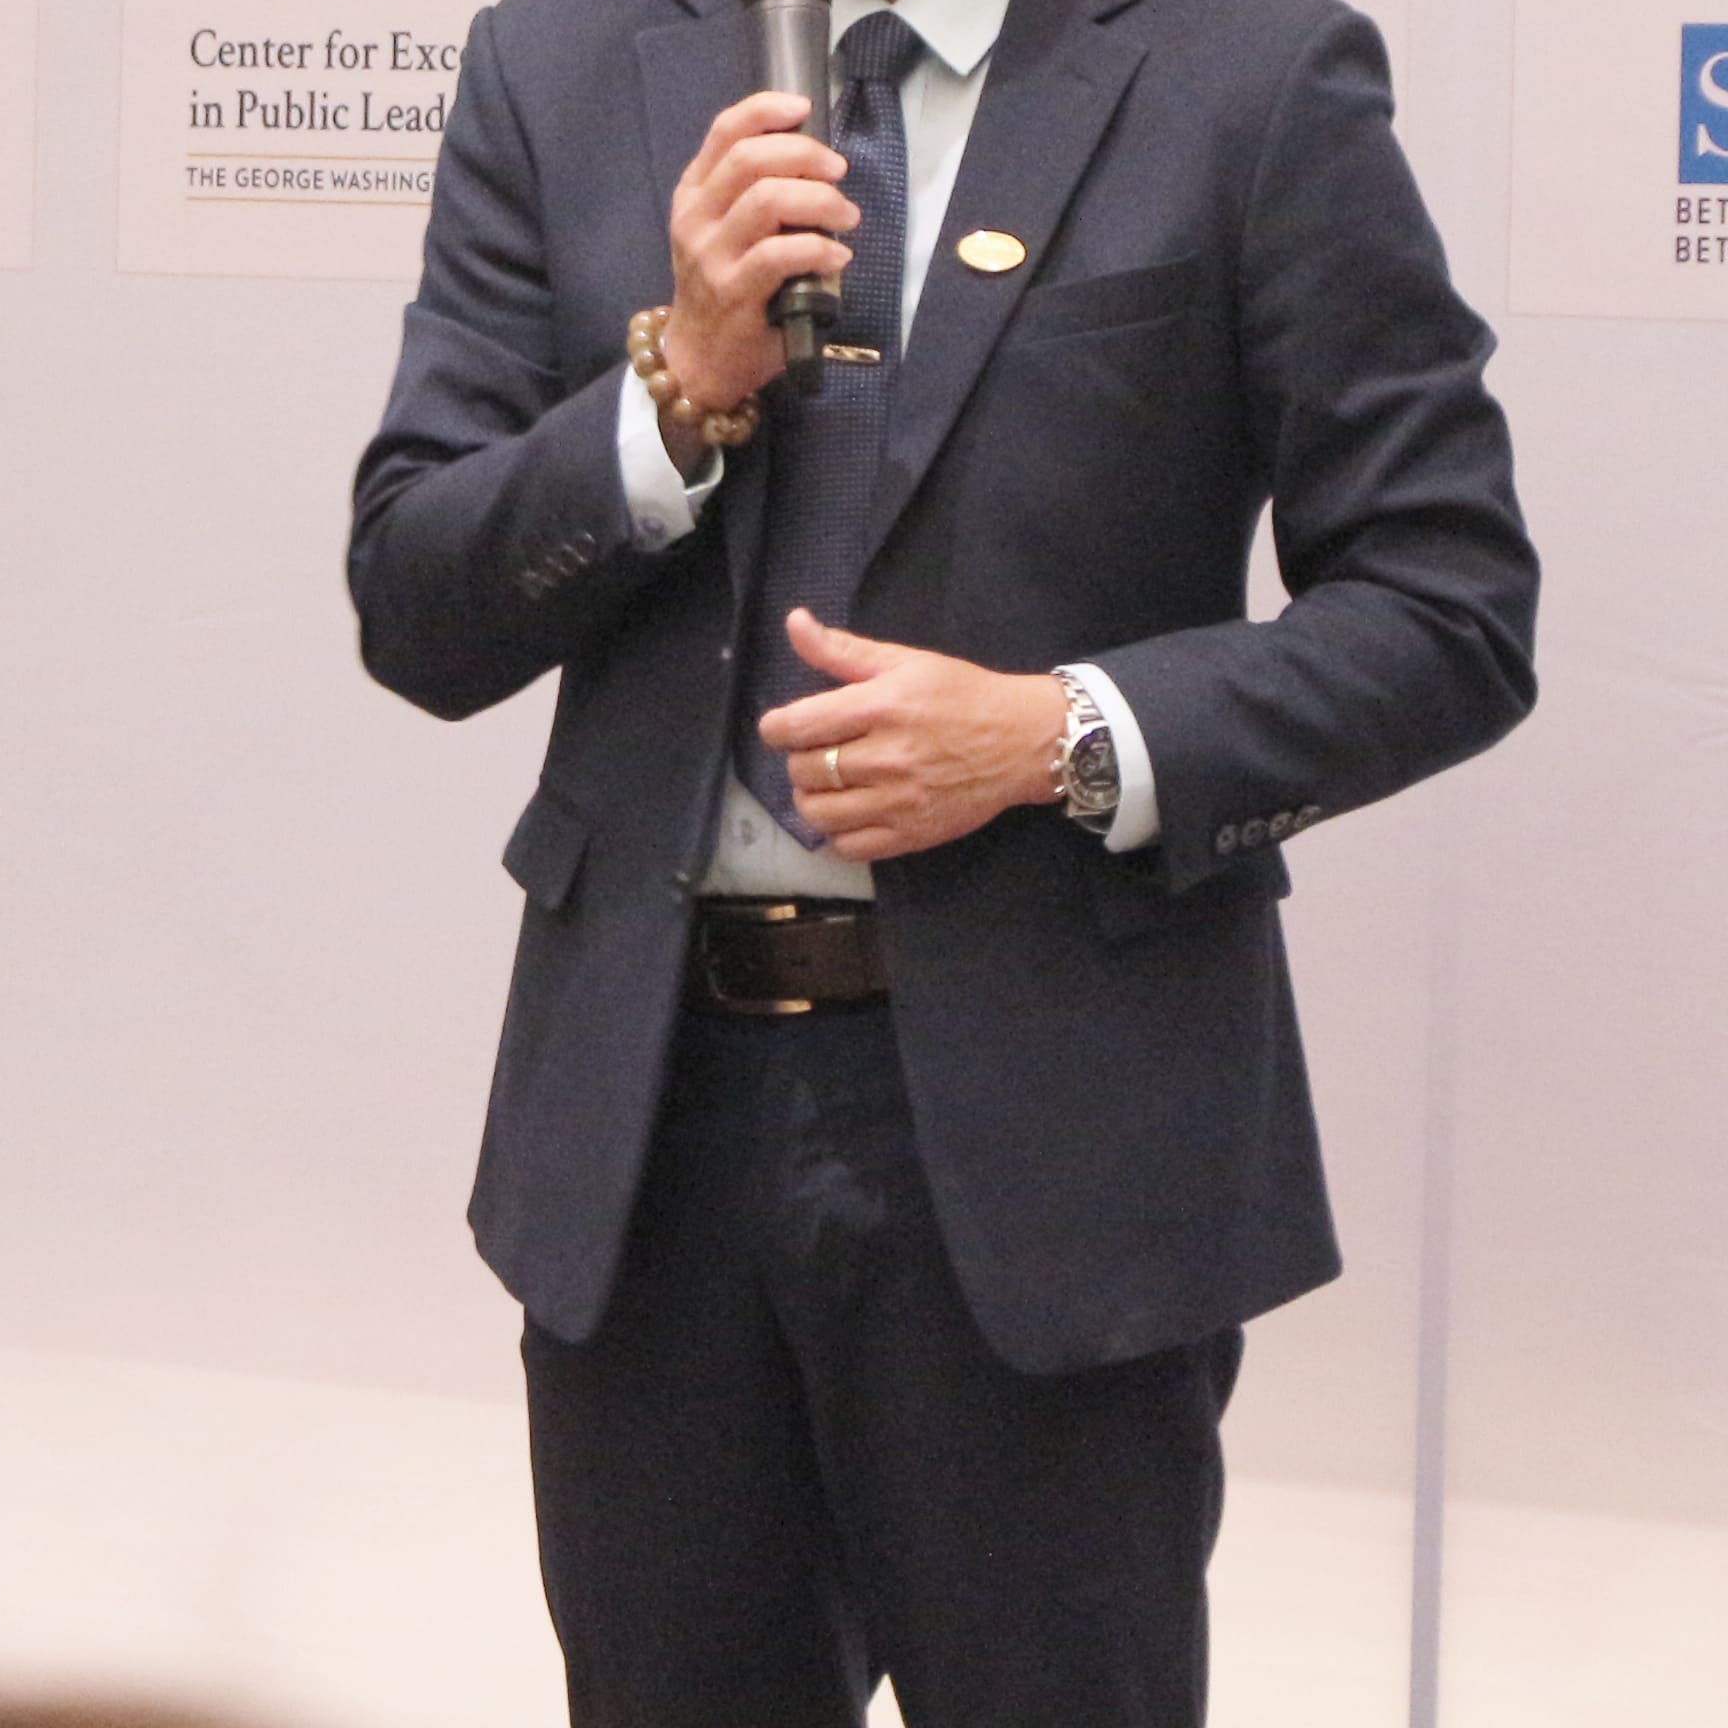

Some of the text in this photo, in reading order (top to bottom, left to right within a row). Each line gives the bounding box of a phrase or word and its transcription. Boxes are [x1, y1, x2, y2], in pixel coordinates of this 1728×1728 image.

[189, 28, 464, 72] Center for Exc
[189, 89, 446, 133] in Public Lead
[186, 166, 435, 193] THE GEORGE WASHING
